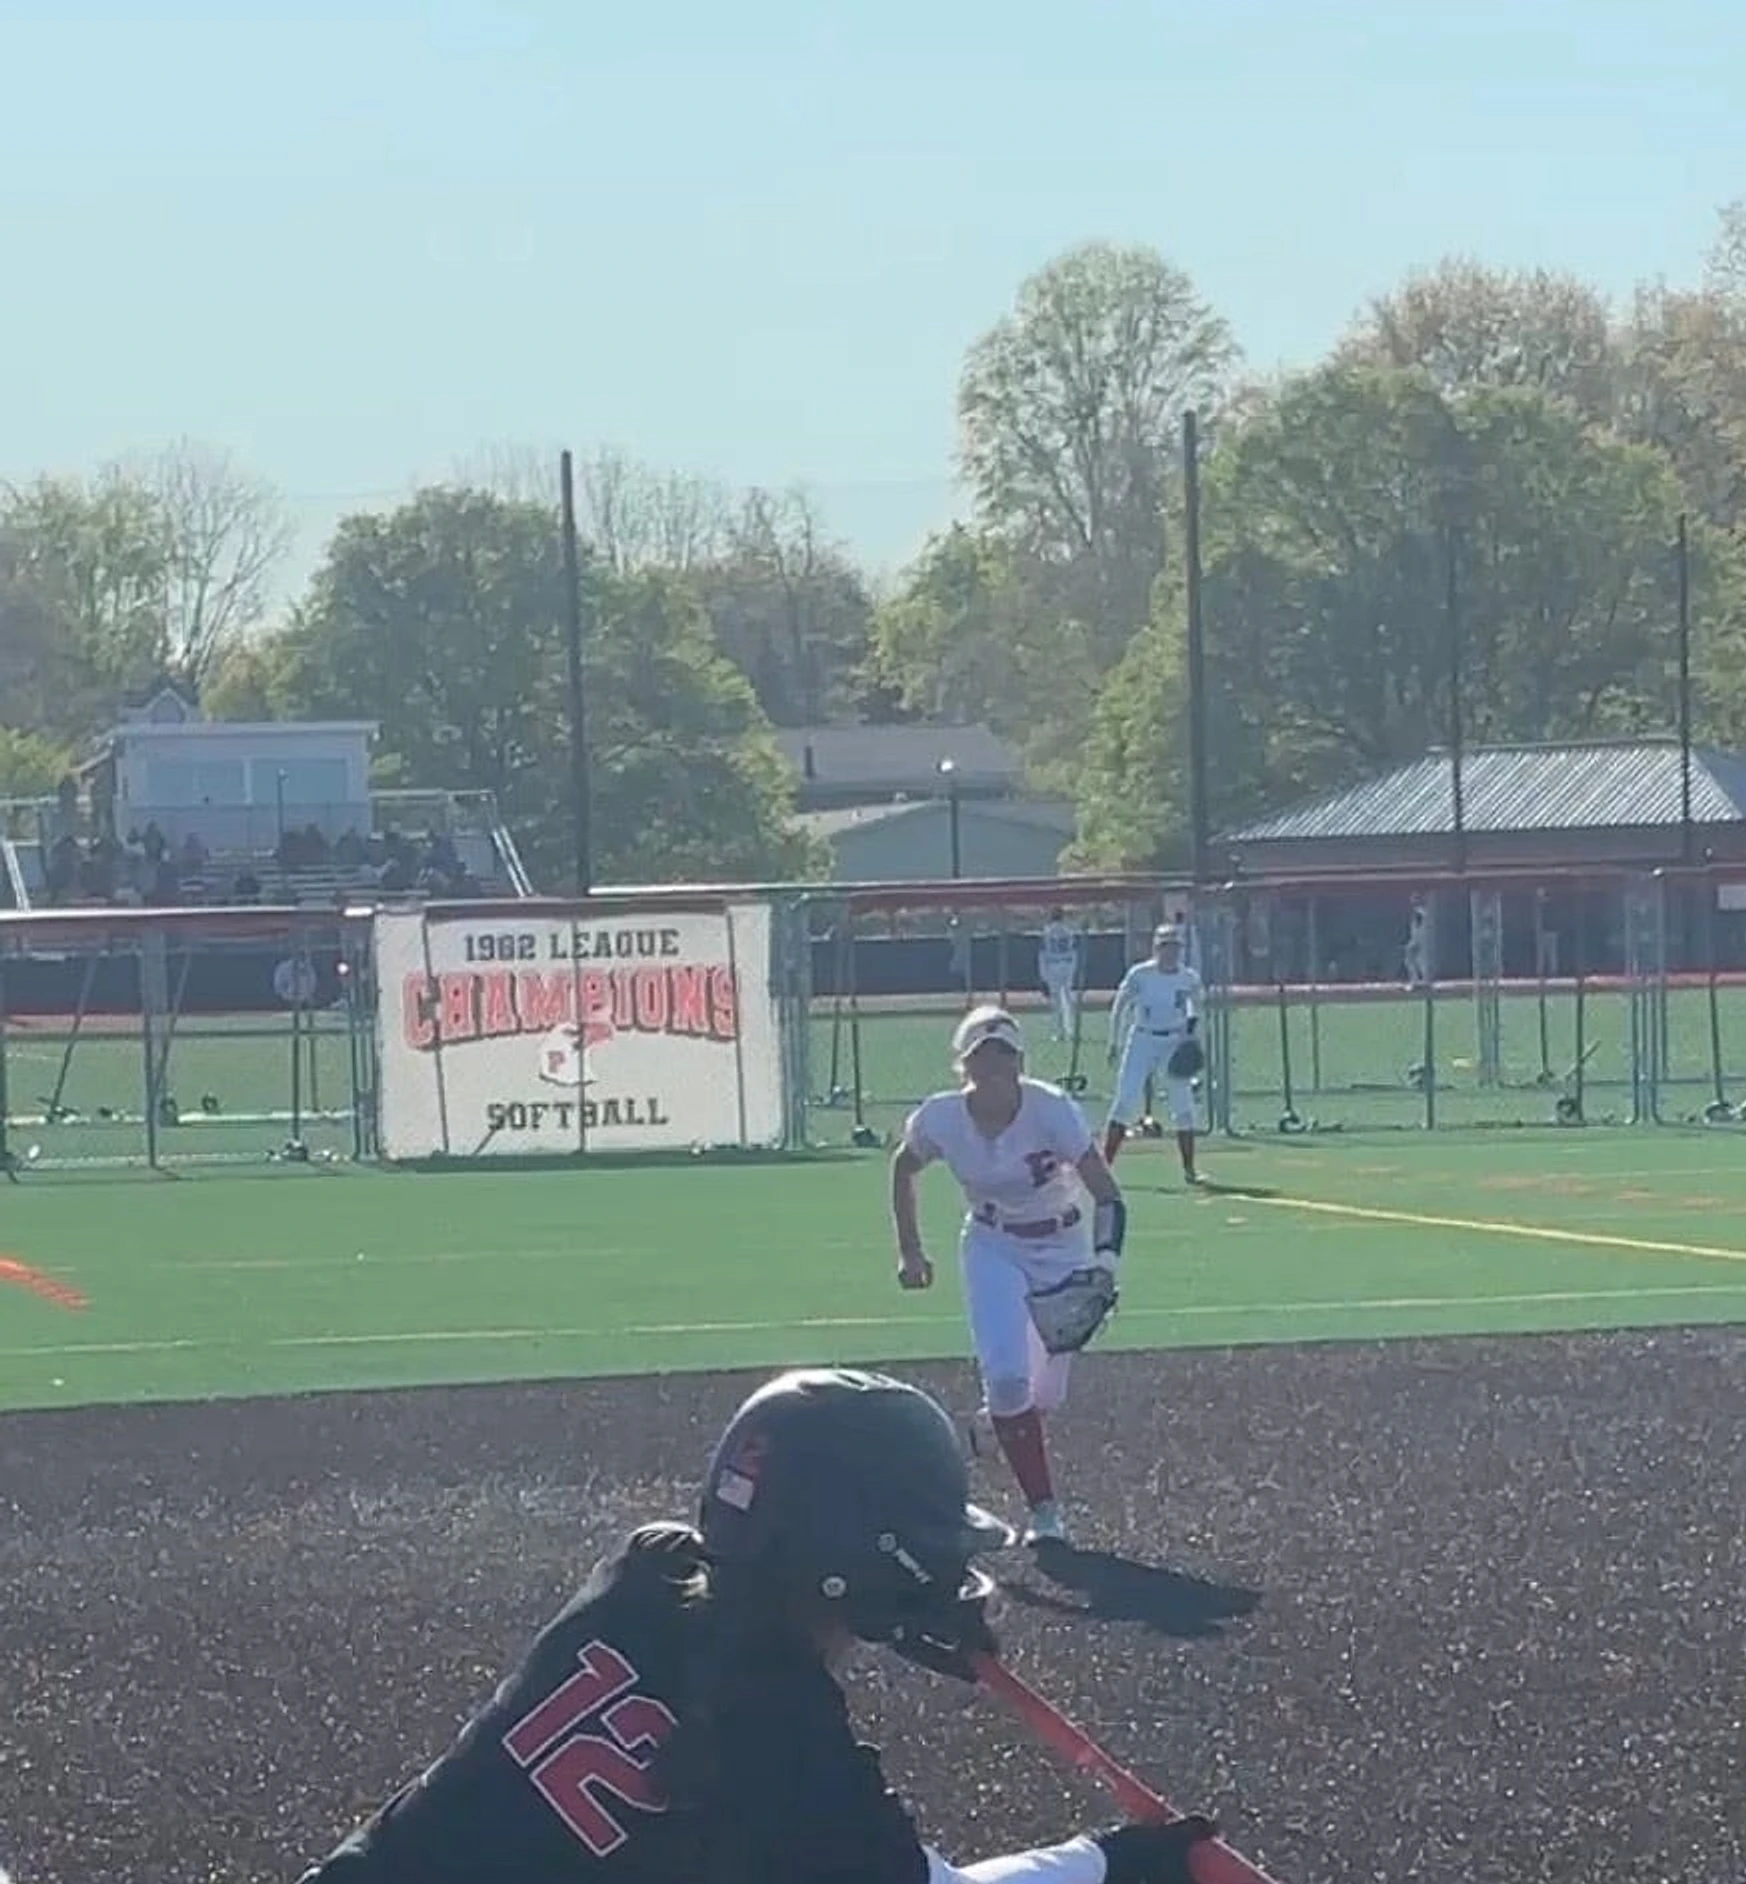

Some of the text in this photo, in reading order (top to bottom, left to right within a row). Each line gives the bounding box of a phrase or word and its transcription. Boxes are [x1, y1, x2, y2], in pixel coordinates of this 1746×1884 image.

[550, 928, 680, 959] LEAGUE
[403, 964, 738, 1049] CHAMPIONS
[487, 1098, 669, 1131] SOFTBALL
[502, 1639, 679, 1857] 12
